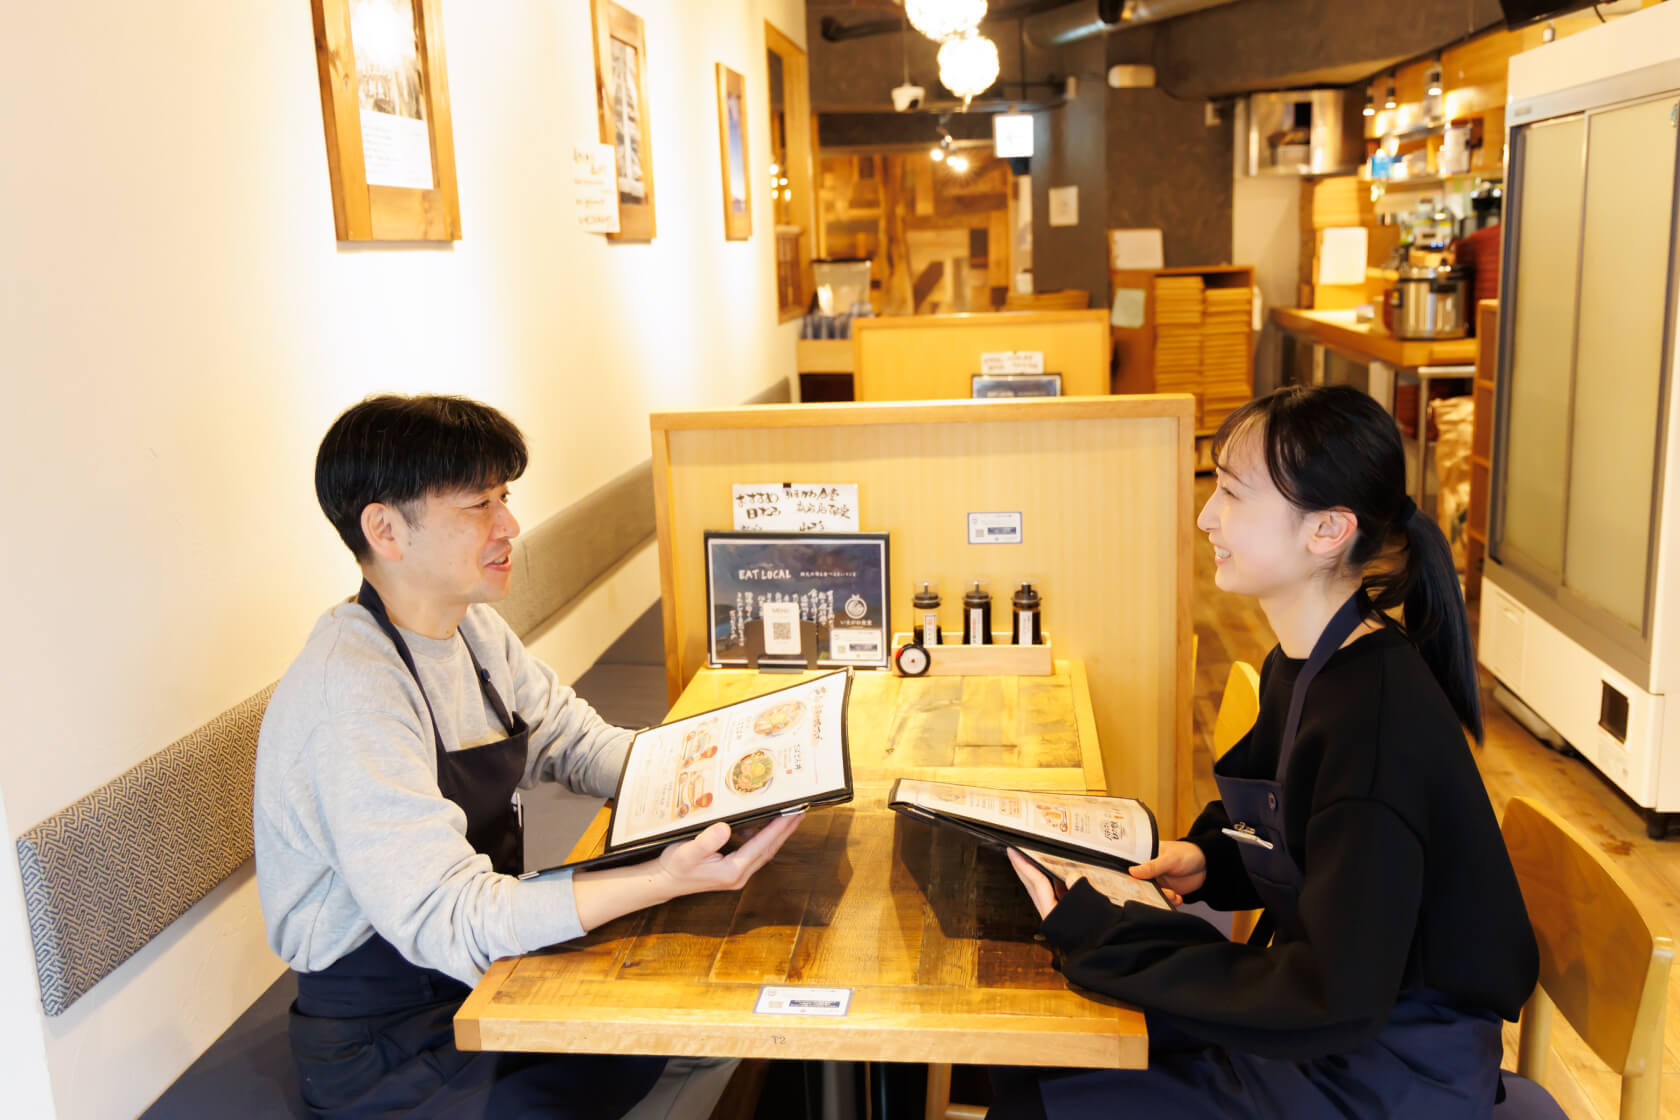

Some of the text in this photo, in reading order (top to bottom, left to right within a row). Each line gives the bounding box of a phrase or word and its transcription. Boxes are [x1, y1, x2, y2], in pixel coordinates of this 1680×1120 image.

[738, 569, 791, 580] EAT LOCAL
[771, 1034, 786, 1045] T2
